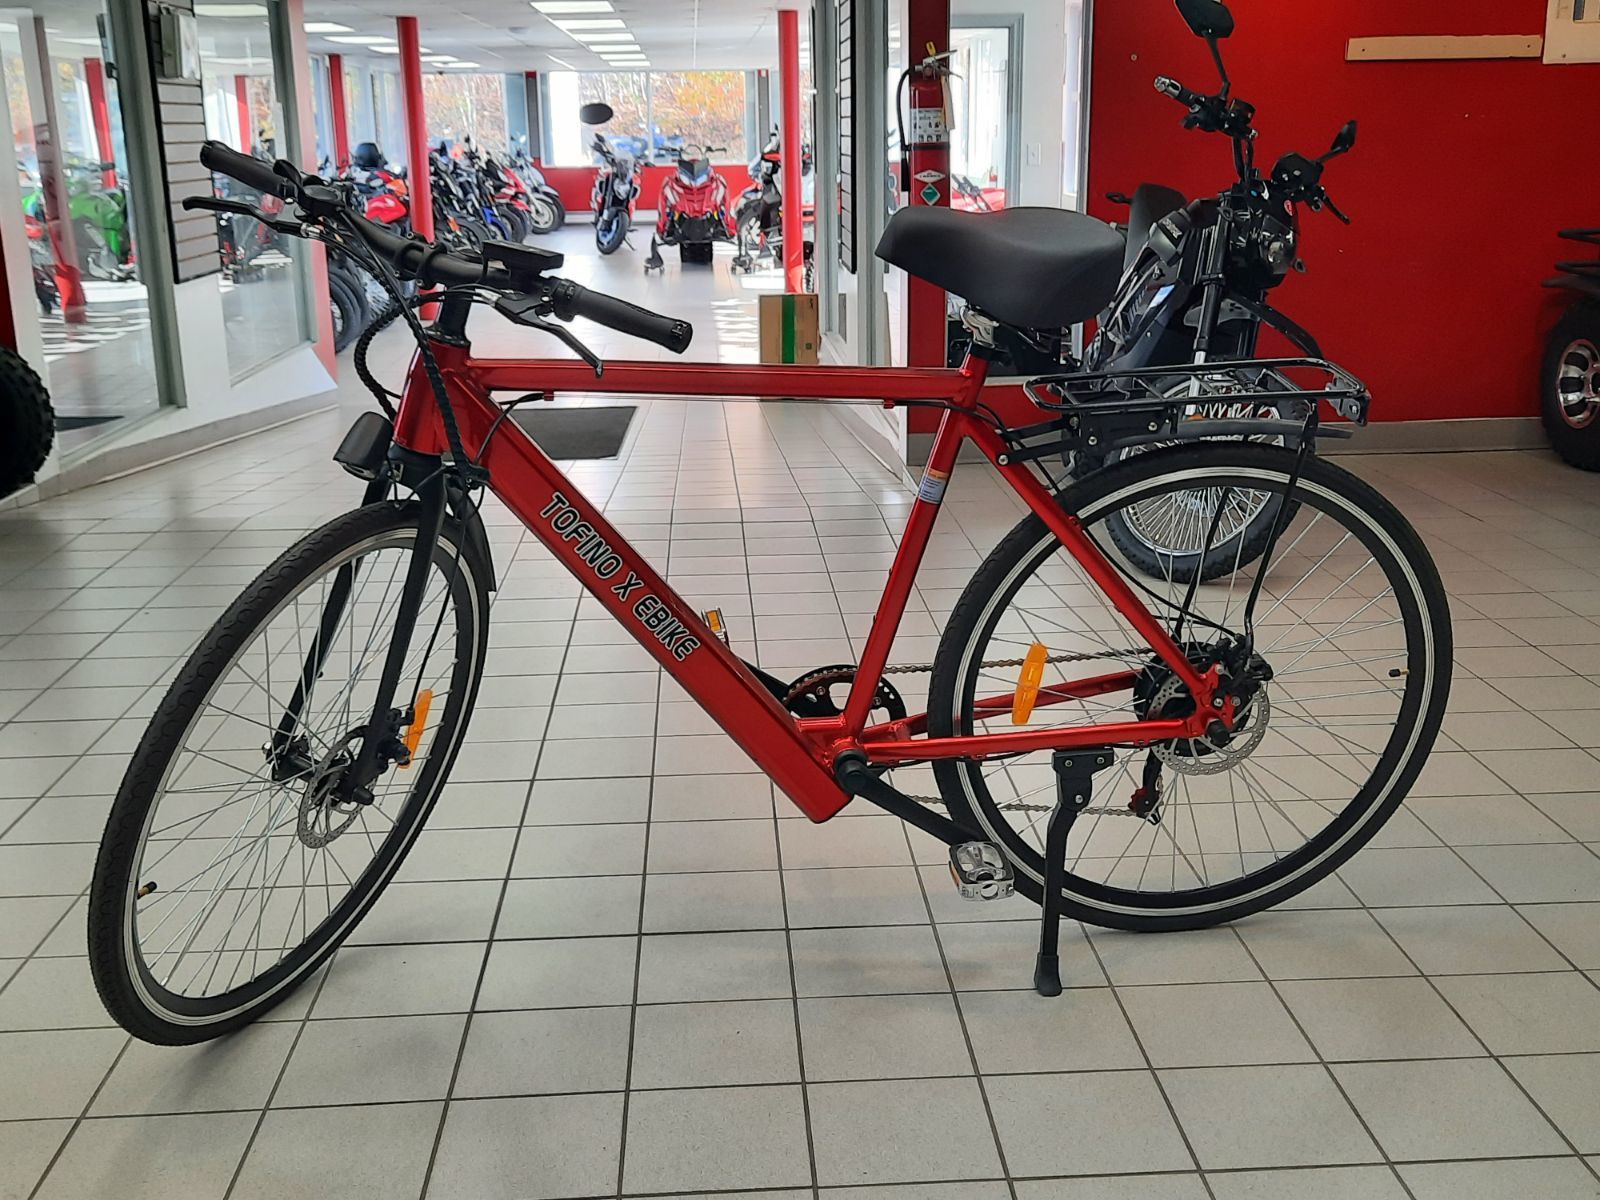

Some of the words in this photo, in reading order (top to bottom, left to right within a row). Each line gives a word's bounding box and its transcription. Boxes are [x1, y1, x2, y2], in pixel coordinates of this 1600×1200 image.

[539, 491, 624, 580] TOFINO
[611, 571, 644, 602] X
[632, 594, 701, 662] EBIKE
